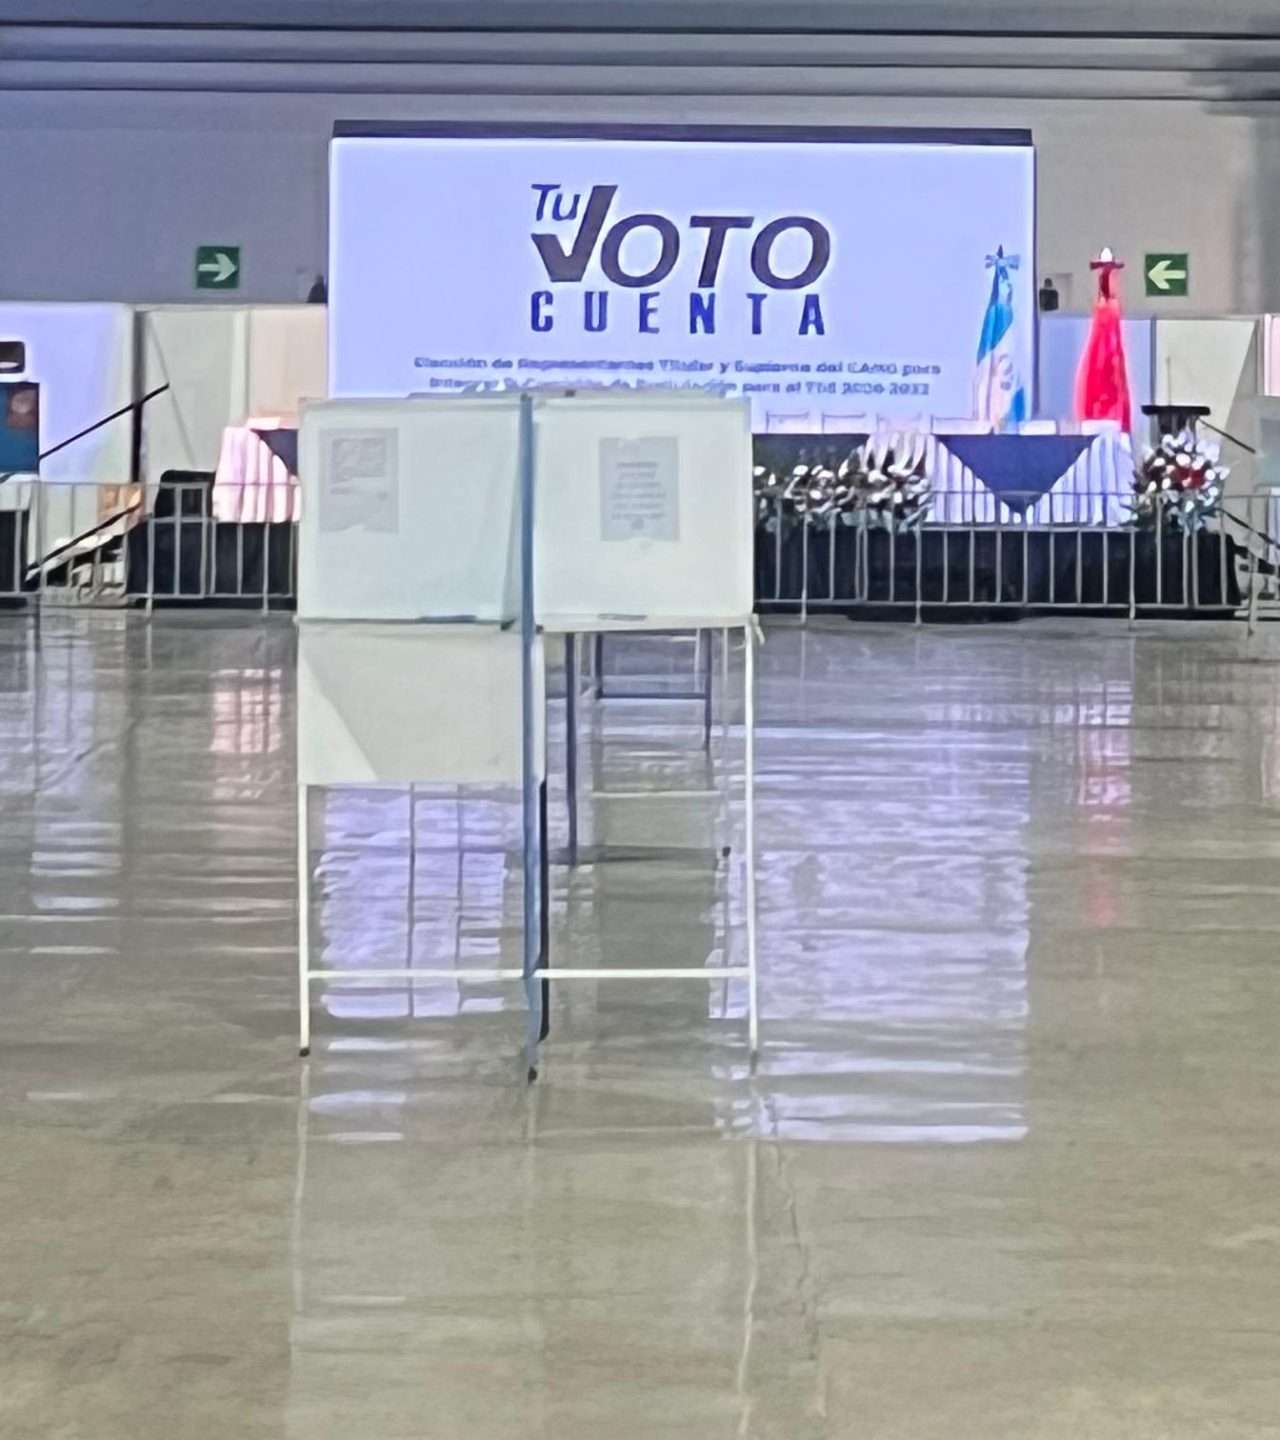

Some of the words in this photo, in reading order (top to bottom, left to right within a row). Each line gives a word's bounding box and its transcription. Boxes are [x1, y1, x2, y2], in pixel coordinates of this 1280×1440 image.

[530, 183, 582, 222] Tu
[530, 184, 831, 290] VOTO
[530, 290, 826, 336] CUENTA
